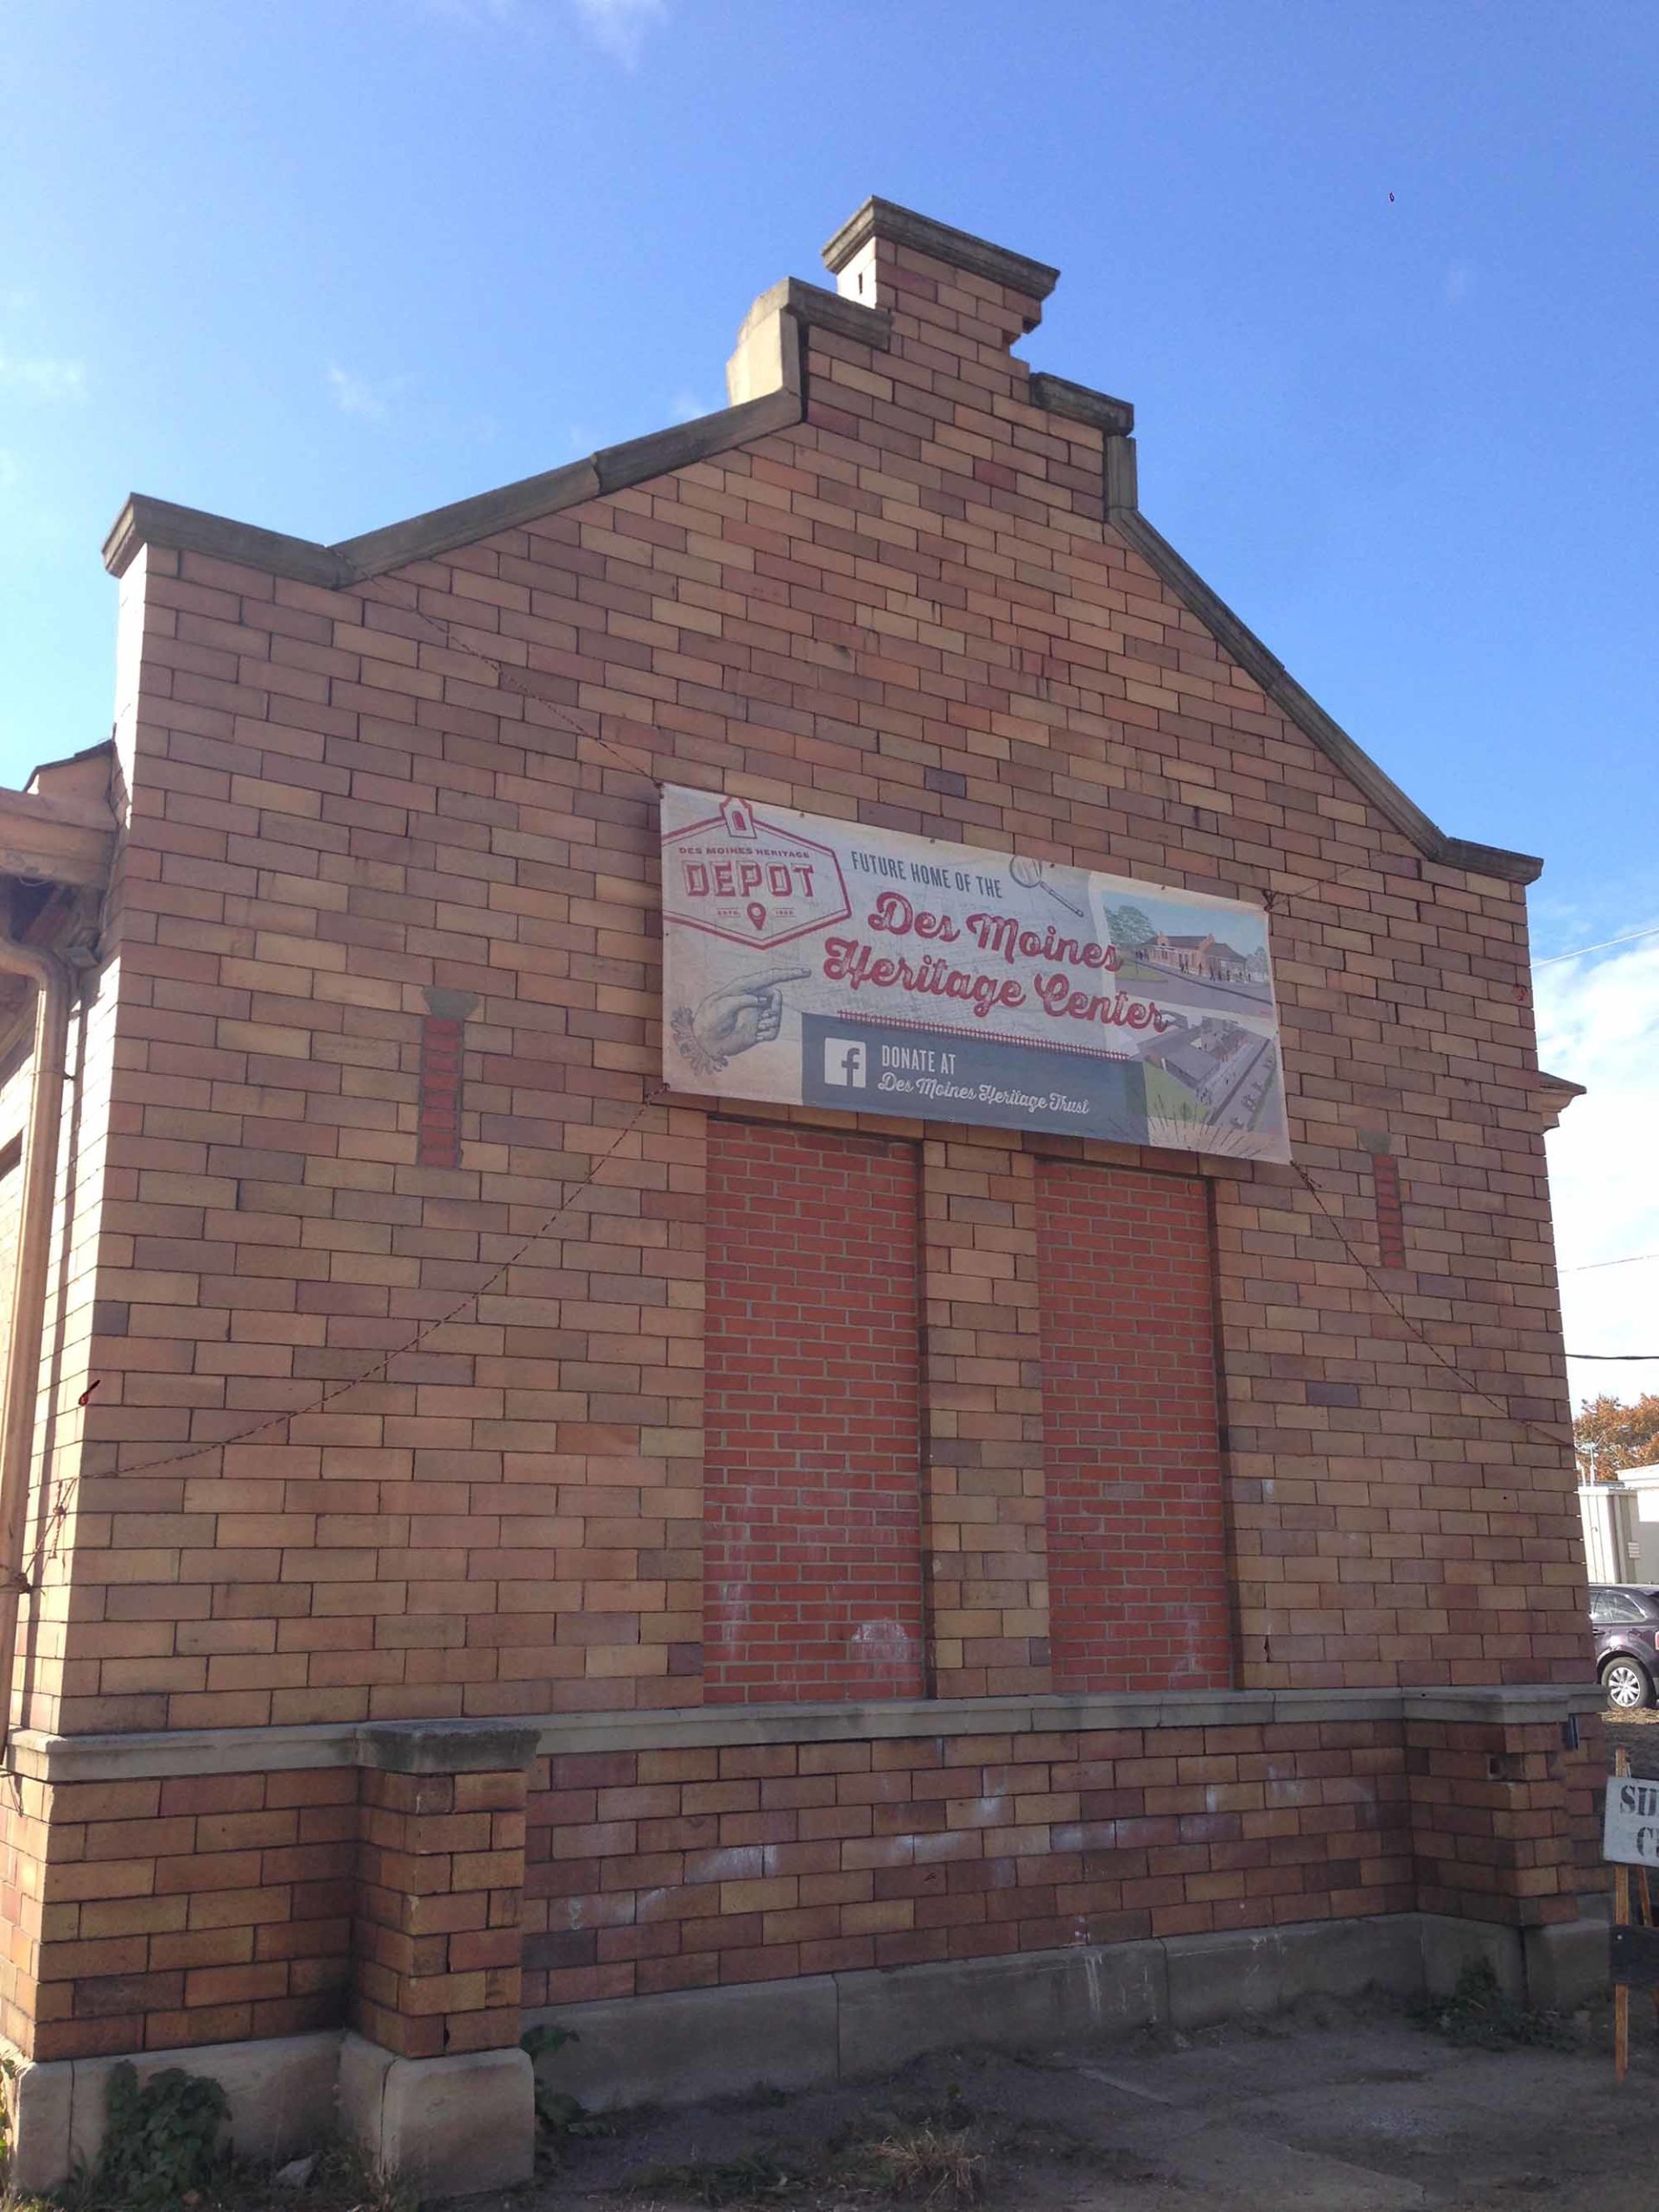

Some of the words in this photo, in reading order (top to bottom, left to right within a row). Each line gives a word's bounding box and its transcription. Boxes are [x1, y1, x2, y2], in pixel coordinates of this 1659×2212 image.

[706, 847, 753, 855] MOINES
[755, 849, 810, 859] HERITAGE
[850, 850, 906, 880] FUTURE
[910, 862, 951, 889] HOME
[955, 872, 970, 893] OF
[976, 875, 1003, 899] THE
[682, 860, 815, 898] DEPOT
[868, 891, 960, 943] Des
[966, 912, 1123, 973] Moines
[823, 936, 1027, 1018] Heritage
[1034, 973, 1173, 1033] Center
[881, 1045, 936, 1073] DONATE
[940, 1052, 957, 1076] AT
[877, 1071, 915, 1094] Des
[916, 1077, 978, 1100] Moines
[978, 1084, 1049, 1114] Heritage
[1049, 1091, 1091, 1115] Trust
